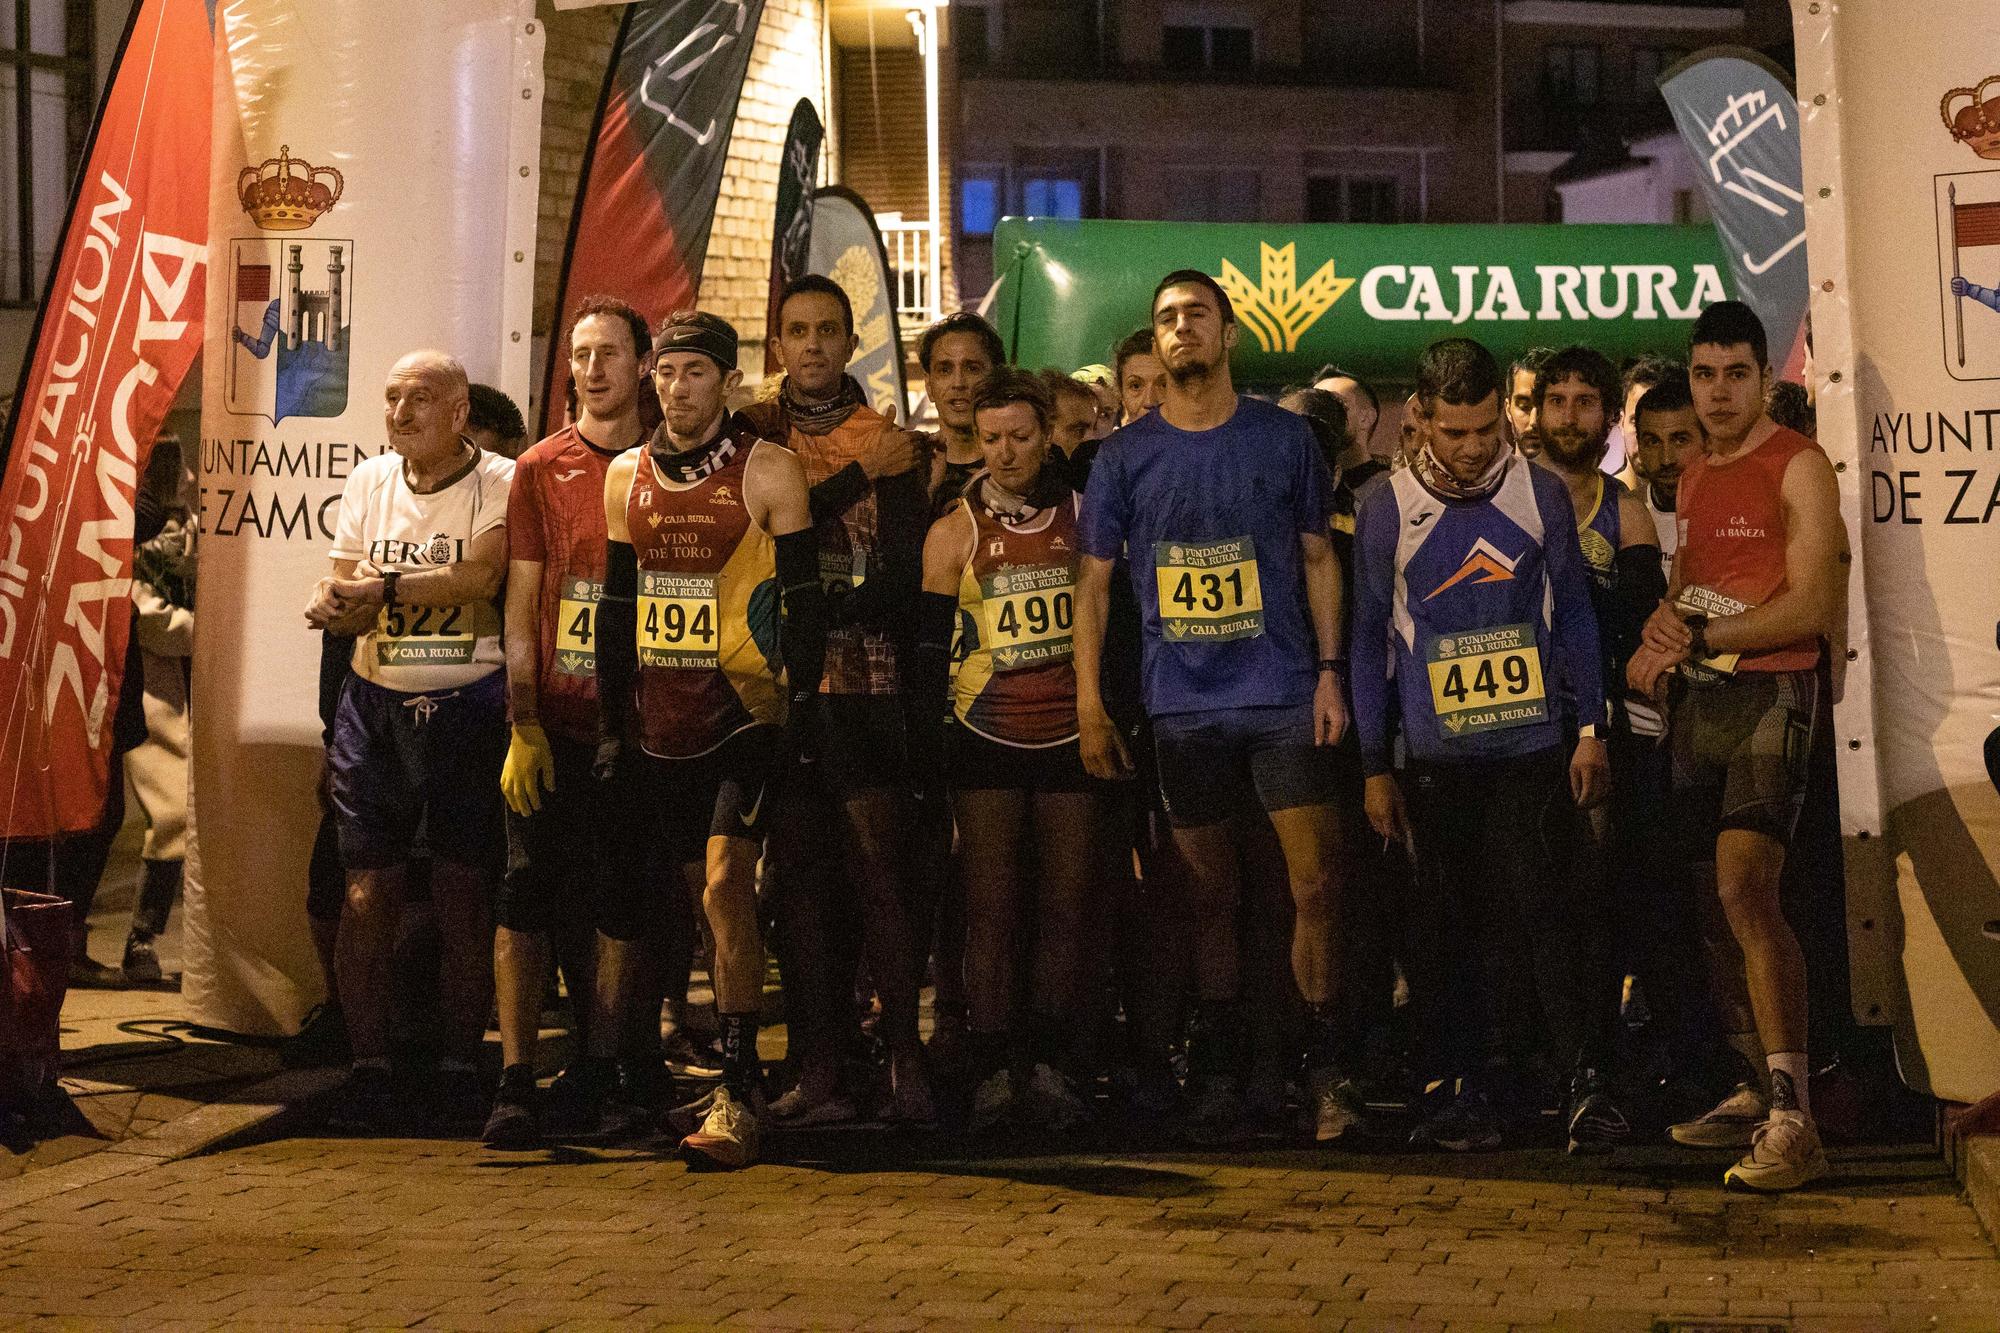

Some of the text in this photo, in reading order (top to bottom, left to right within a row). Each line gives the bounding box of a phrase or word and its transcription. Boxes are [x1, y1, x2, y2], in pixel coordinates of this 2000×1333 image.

[1360, 265, 1530, 324] CAJA
[72, 412, 97, 464] DE
[1870, 409, 2000, 454] AYUNT
[1872, 470, 1922, 524] DE
[664, 514, 716, 524] CAJA RURAL
[1730, 515, 1748, 525] C.A.
[661, 532, 698, 544] VINO
[1716, 525, 1766, 538] LA BAÑEZA
[649, 546, 712, 560] DE TORO
[1185, 542, 1241, 558] FUNDACION
[1186, 551, 1242, 567] CAJA RURAL
[656, 577, 714, 590] FUNDACION
[1010, 566, 1069, 584] FUNDACION
[1012, 575, 1070, 592] CAJA RURAL
[656, 587, 713, 597] CAJA RURAL
[1173, 568, 1243, 612] 431
[1691, 595, 1741, 616] CAJA RURA
[1693, 586, 1747, 613] FUNDACION
[386, 601, 462, 637] 522
[644, 602, 714, 644] 494
[997, 591, 1073, 638] 490
[1190, 618, 1259, 635] CAJA RURAL
[1458, 629, 1521, 646] FUNDACION
[400, 648, 467, 658] CAJA RURAL
[1021, 646, 1050, 660] CAJA
[1459, 638, 1522, 655] CAJA RURAL
[656, 656, 679, 667] CAJA
[1443, 655, 1530, 703] 449
[1469, 706, 1542, 725] CAJA RURAL
